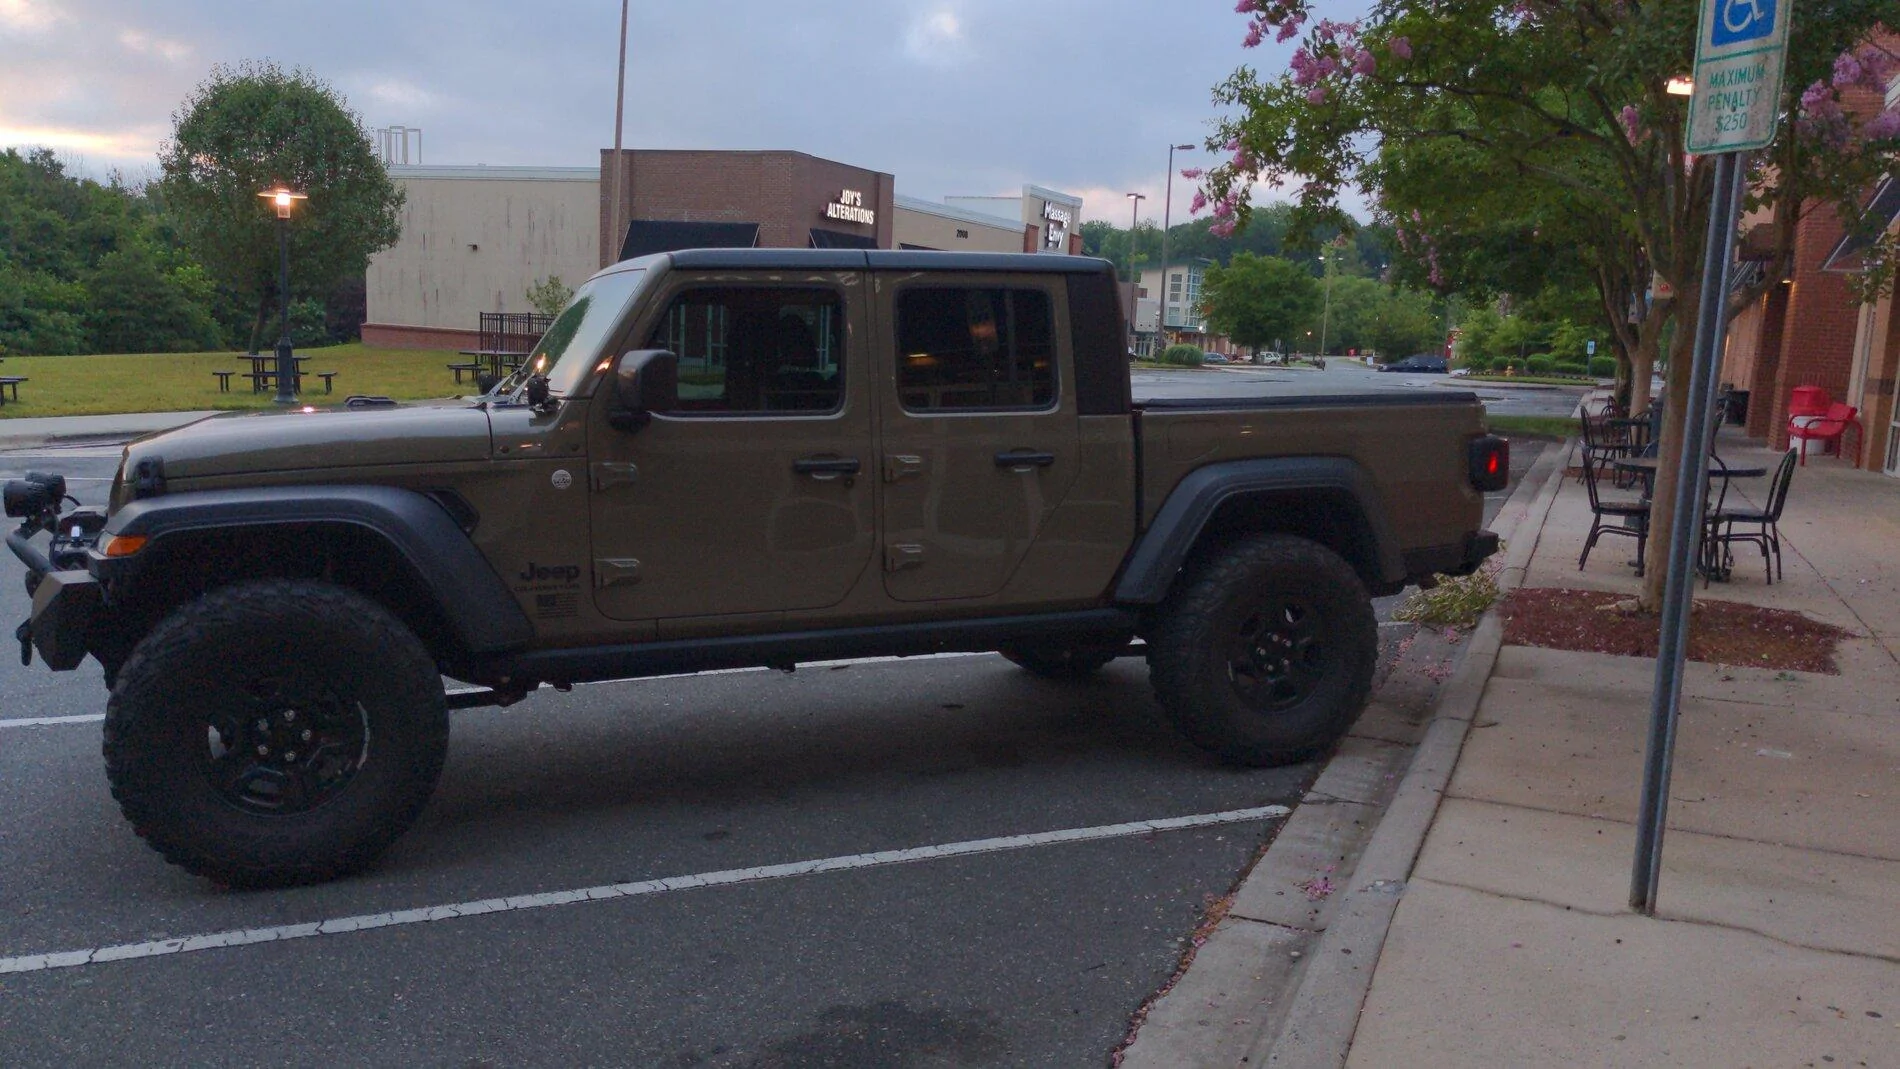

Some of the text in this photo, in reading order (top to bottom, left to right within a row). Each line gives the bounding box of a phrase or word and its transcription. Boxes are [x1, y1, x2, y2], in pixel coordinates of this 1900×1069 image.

[1709, 63, 1765, 88] MAXIMUM
[1708, 88, 1760, 111] PENALTY
[1715, 112, 1748, 133] $250
[840, 189, 861, 206] JOY'S
[827, 202, 875, 225] ALTERATIONS
[1044, 200, 1071, 229] Massage
[1048, 222, 1064, 248] Envy
[520, 561, 580, 583] Jeep
